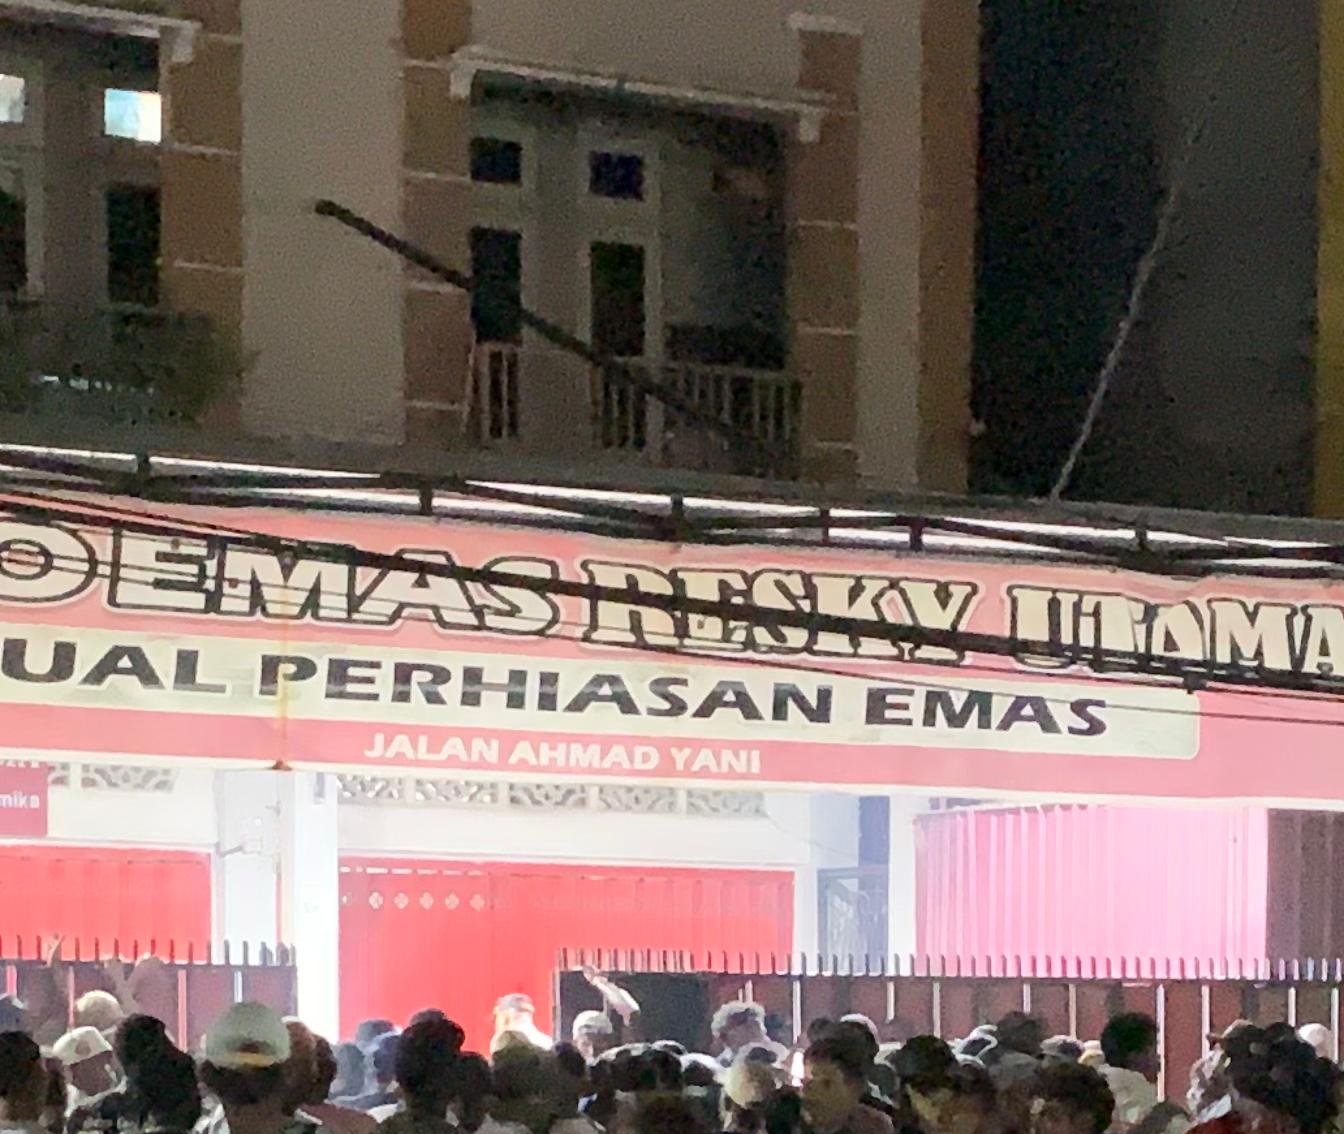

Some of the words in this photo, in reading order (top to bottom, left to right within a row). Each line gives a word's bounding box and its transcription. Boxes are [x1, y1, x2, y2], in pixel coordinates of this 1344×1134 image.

[106, 524, 561, 637] EMAS
[258, 653, 833, 725] PERHIASAN
[864, 685, 1108, 737] EMAS
[363, 732, 500, 764] JALAN
[508, 739, 662, 771] AHMAD
[669, 747, 762, 775] YANI
